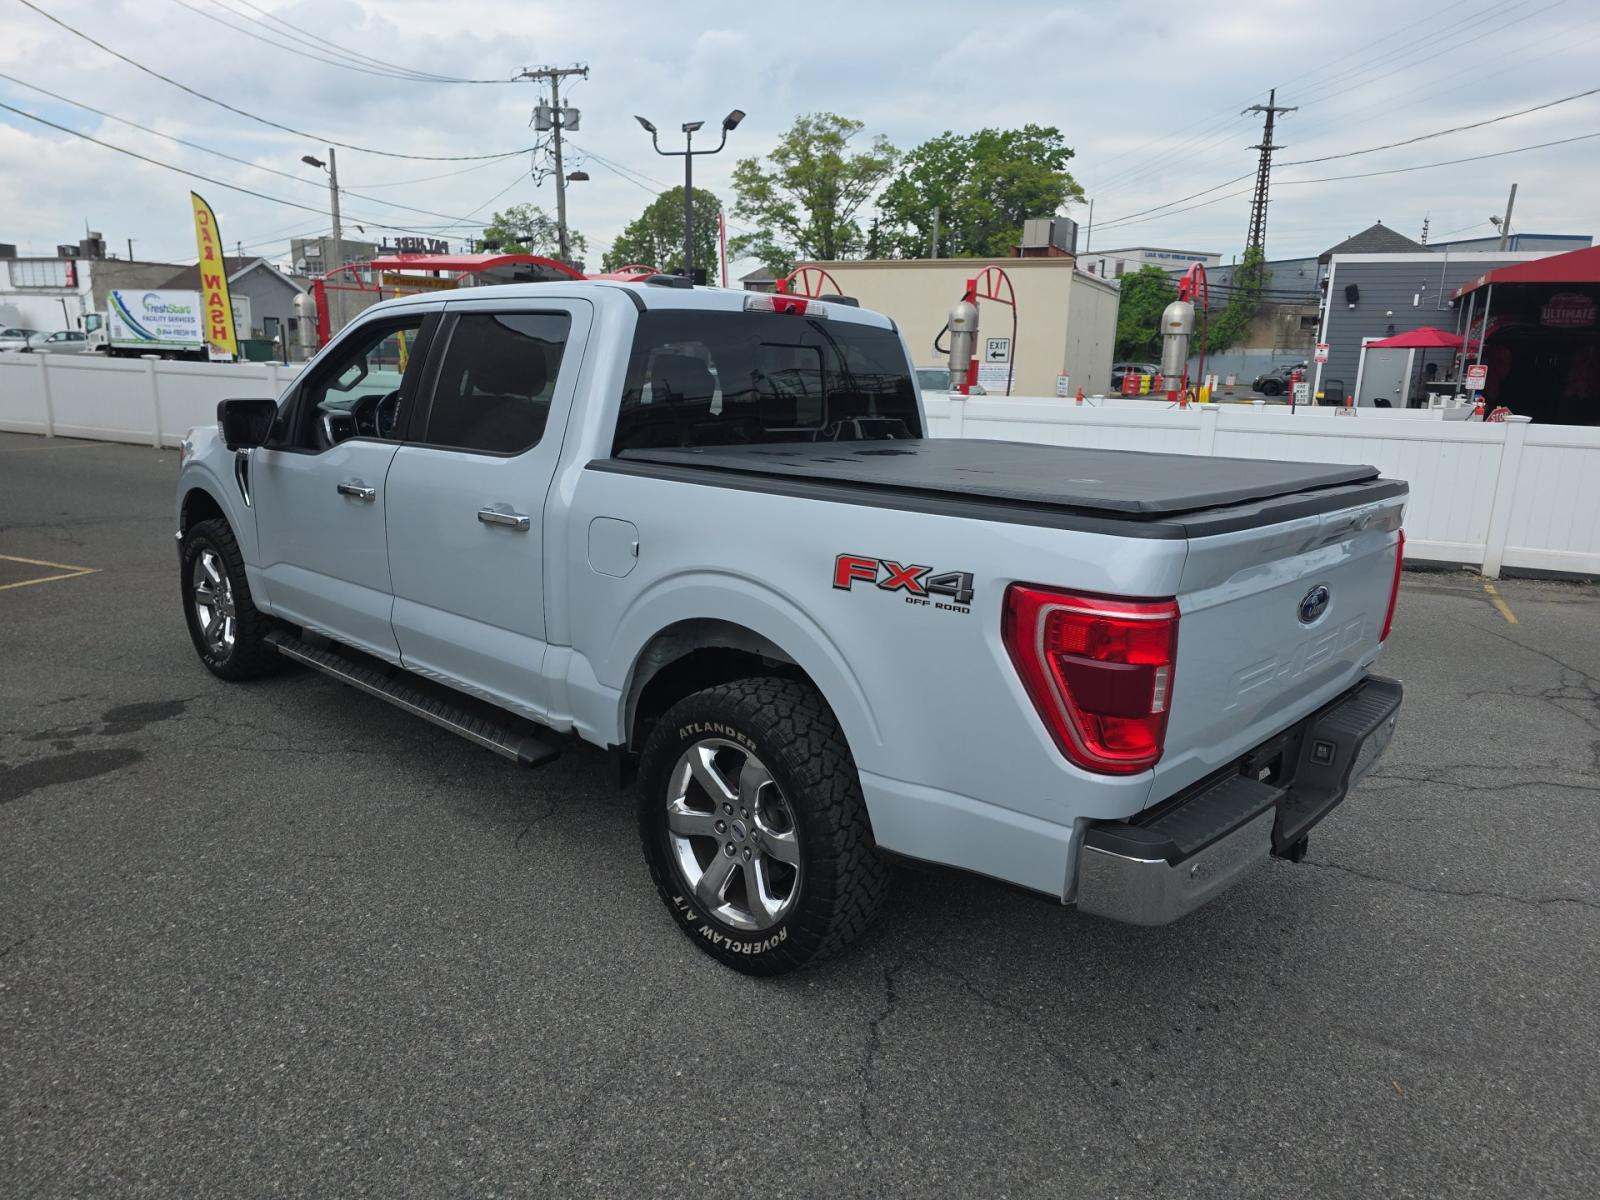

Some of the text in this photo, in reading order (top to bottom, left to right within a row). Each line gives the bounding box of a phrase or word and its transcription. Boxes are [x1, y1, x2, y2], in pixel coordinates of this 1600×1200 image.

[143, 303, 192, 315] FreshStart
[1543, 307, 1597, 320] ULTIMATE
[989, 341, 1008, 350] EXIT
[832, 553, 974, 605] FX4
[905, 596, 971, 614] OFF ROAD
[679, 722, 757, 751] ATLANDER
[698, 925, 788, 955] ROVERCLAW
